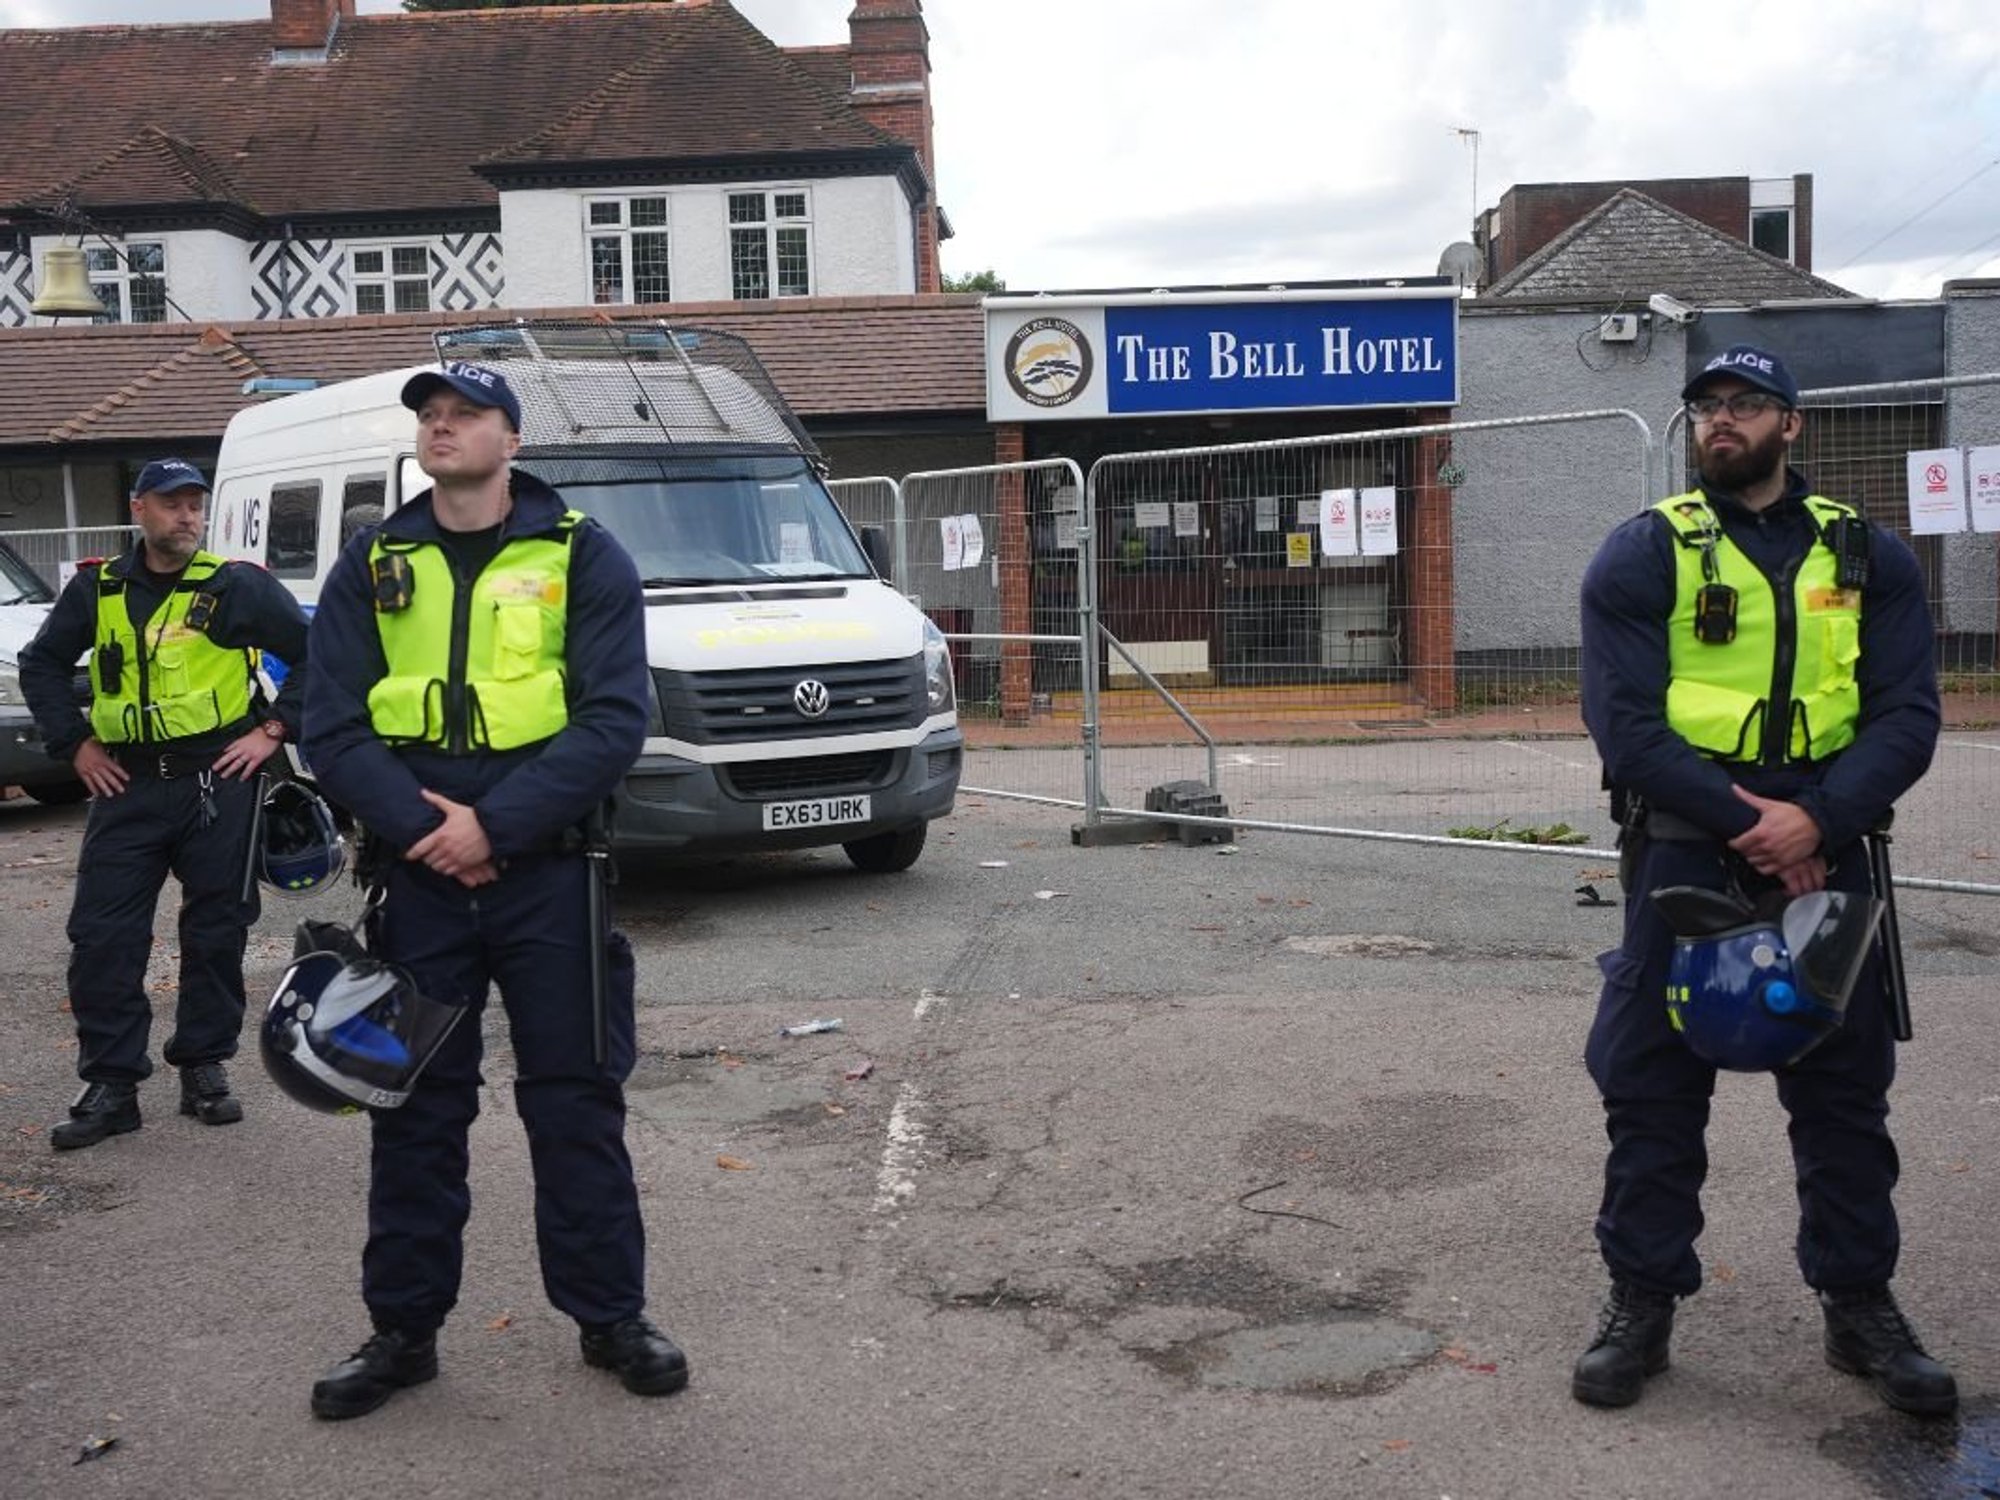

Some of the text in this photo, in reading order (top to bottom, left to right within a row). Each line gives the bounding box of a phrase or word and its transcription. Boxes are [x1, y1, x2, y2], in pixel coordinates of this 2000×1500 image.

[1117, 326, 1442, 382] THE BELL HOTEL
[445, 364, 495, 388] LICE
[772, 799, 864, 826] EX63 URK
